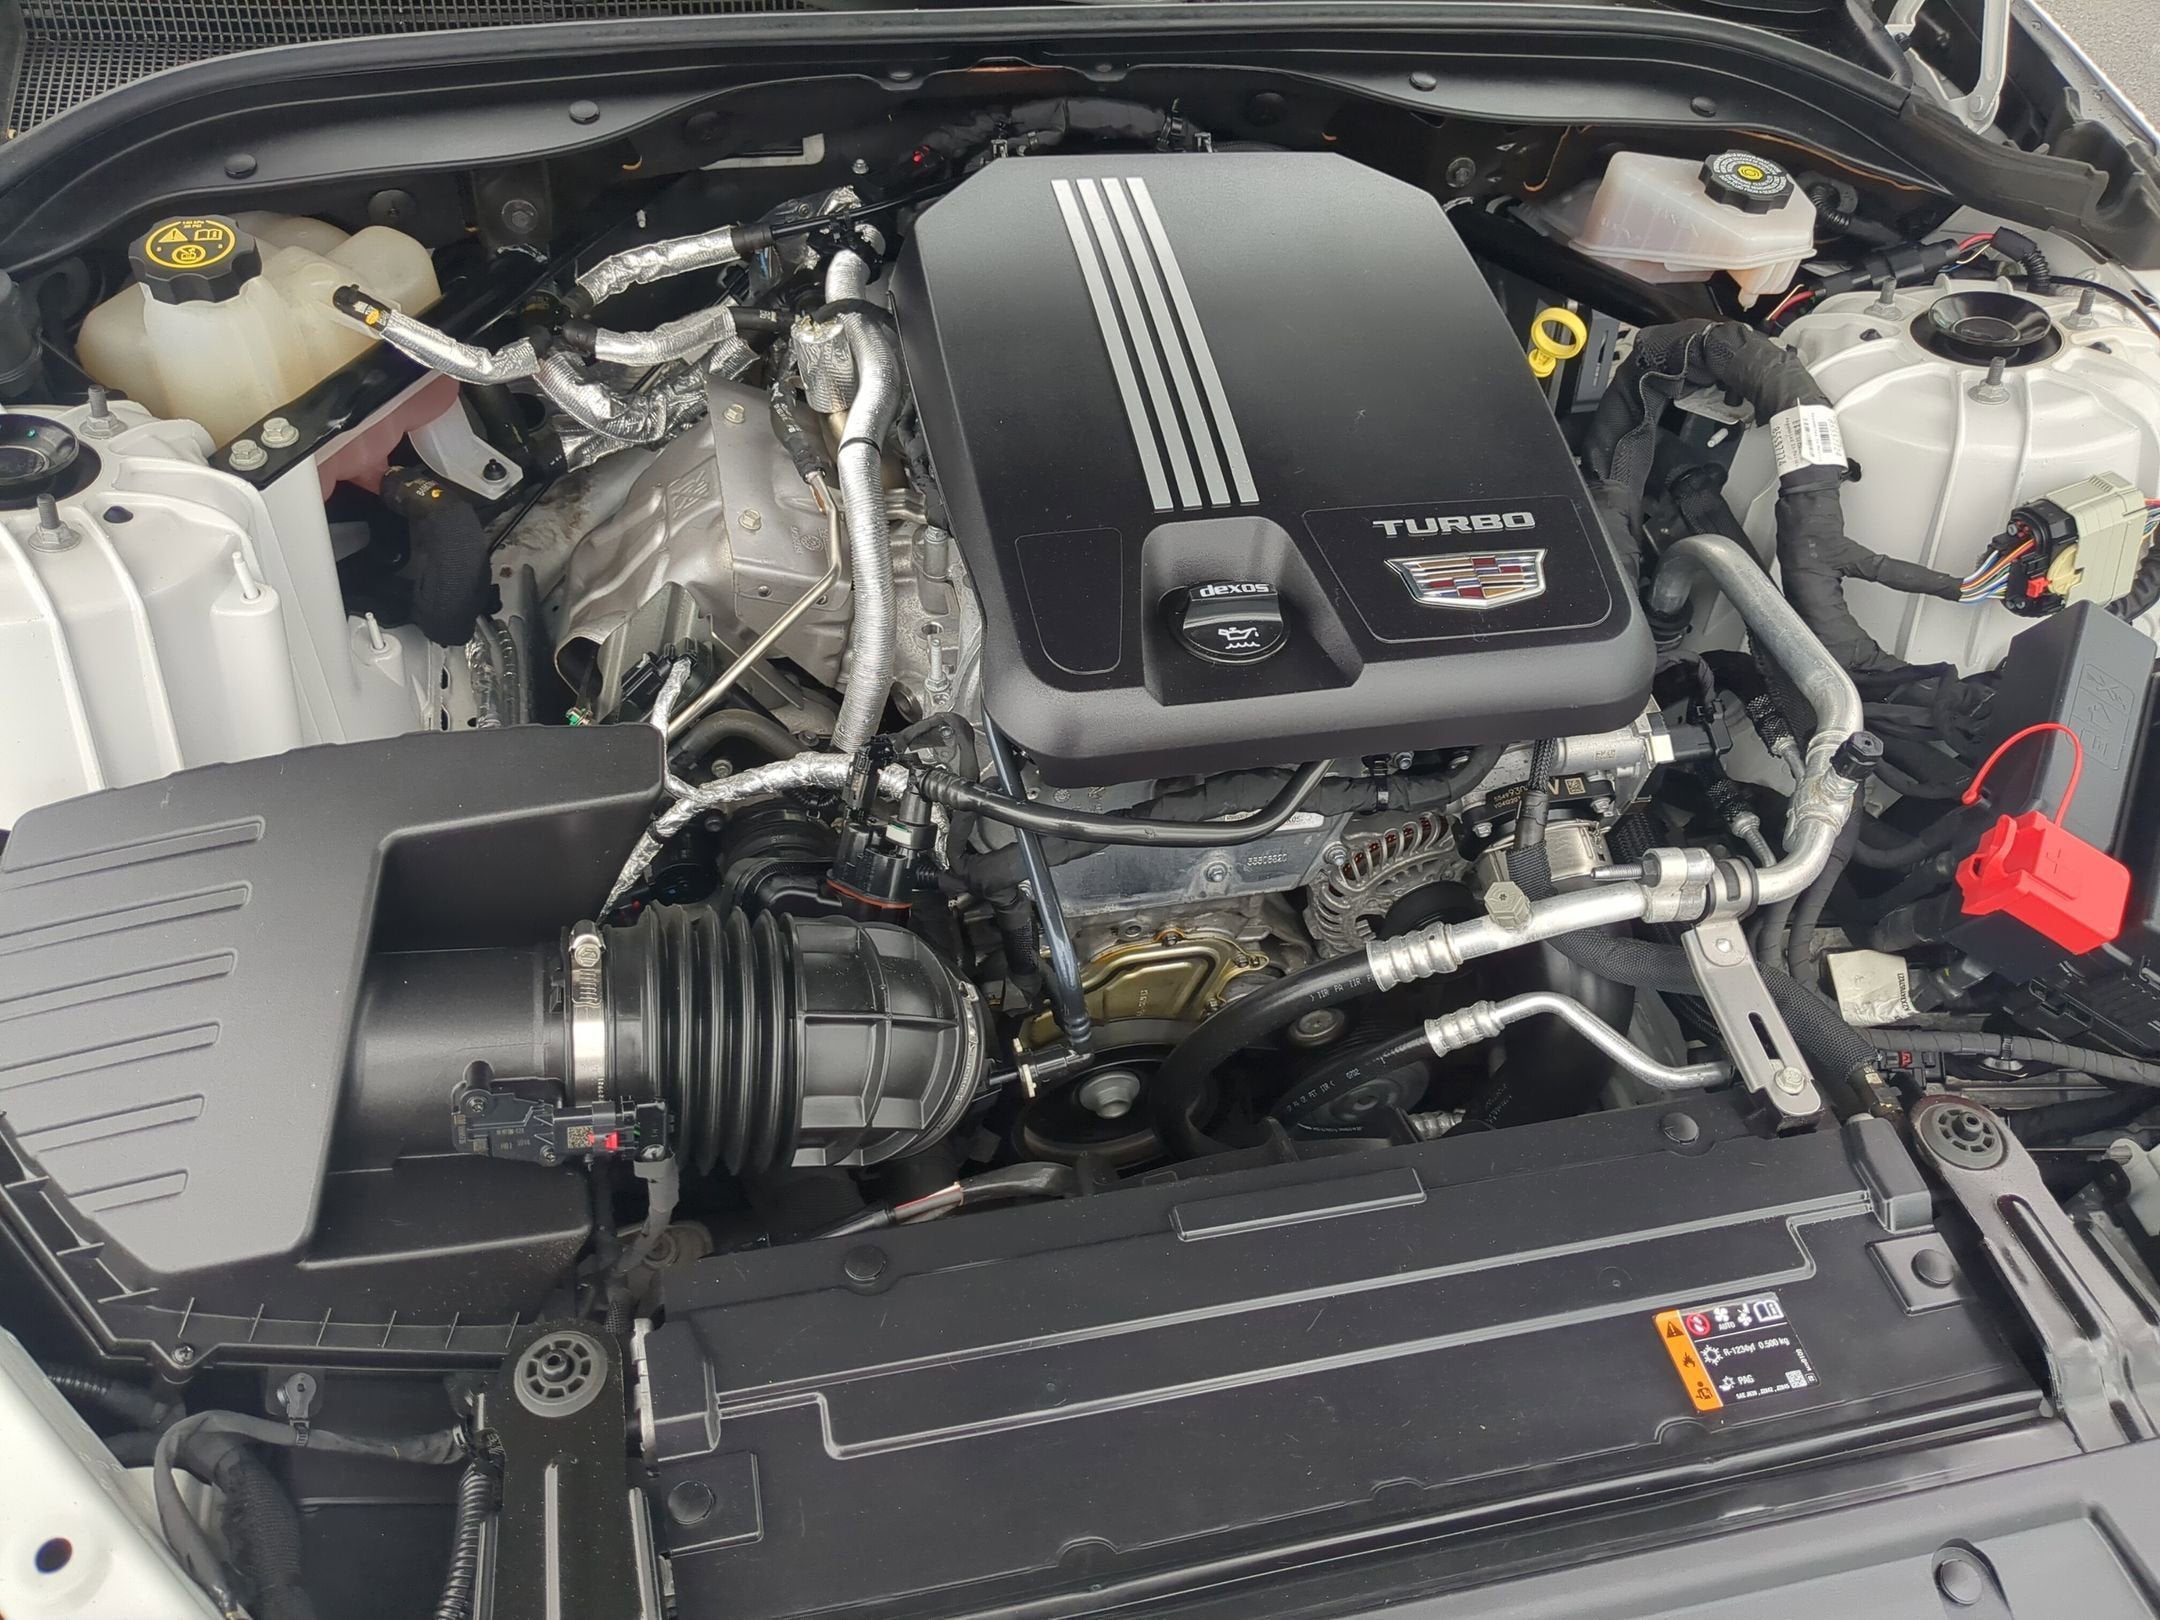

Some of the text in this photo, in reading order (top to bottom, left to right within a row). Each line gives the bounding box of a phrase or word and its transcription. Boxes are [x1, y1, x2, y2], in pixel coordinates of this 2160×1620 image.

[1372, 511, 1536, 538] TURBO
[1199, 582, 1270, 599] dexos
[1719, 1321, 1735, 1331] AUTO
[1723, 1337, 1790, 1357] R-1234yf 0.500 kg
[1737, 1374, 1755, 1386] PAG
